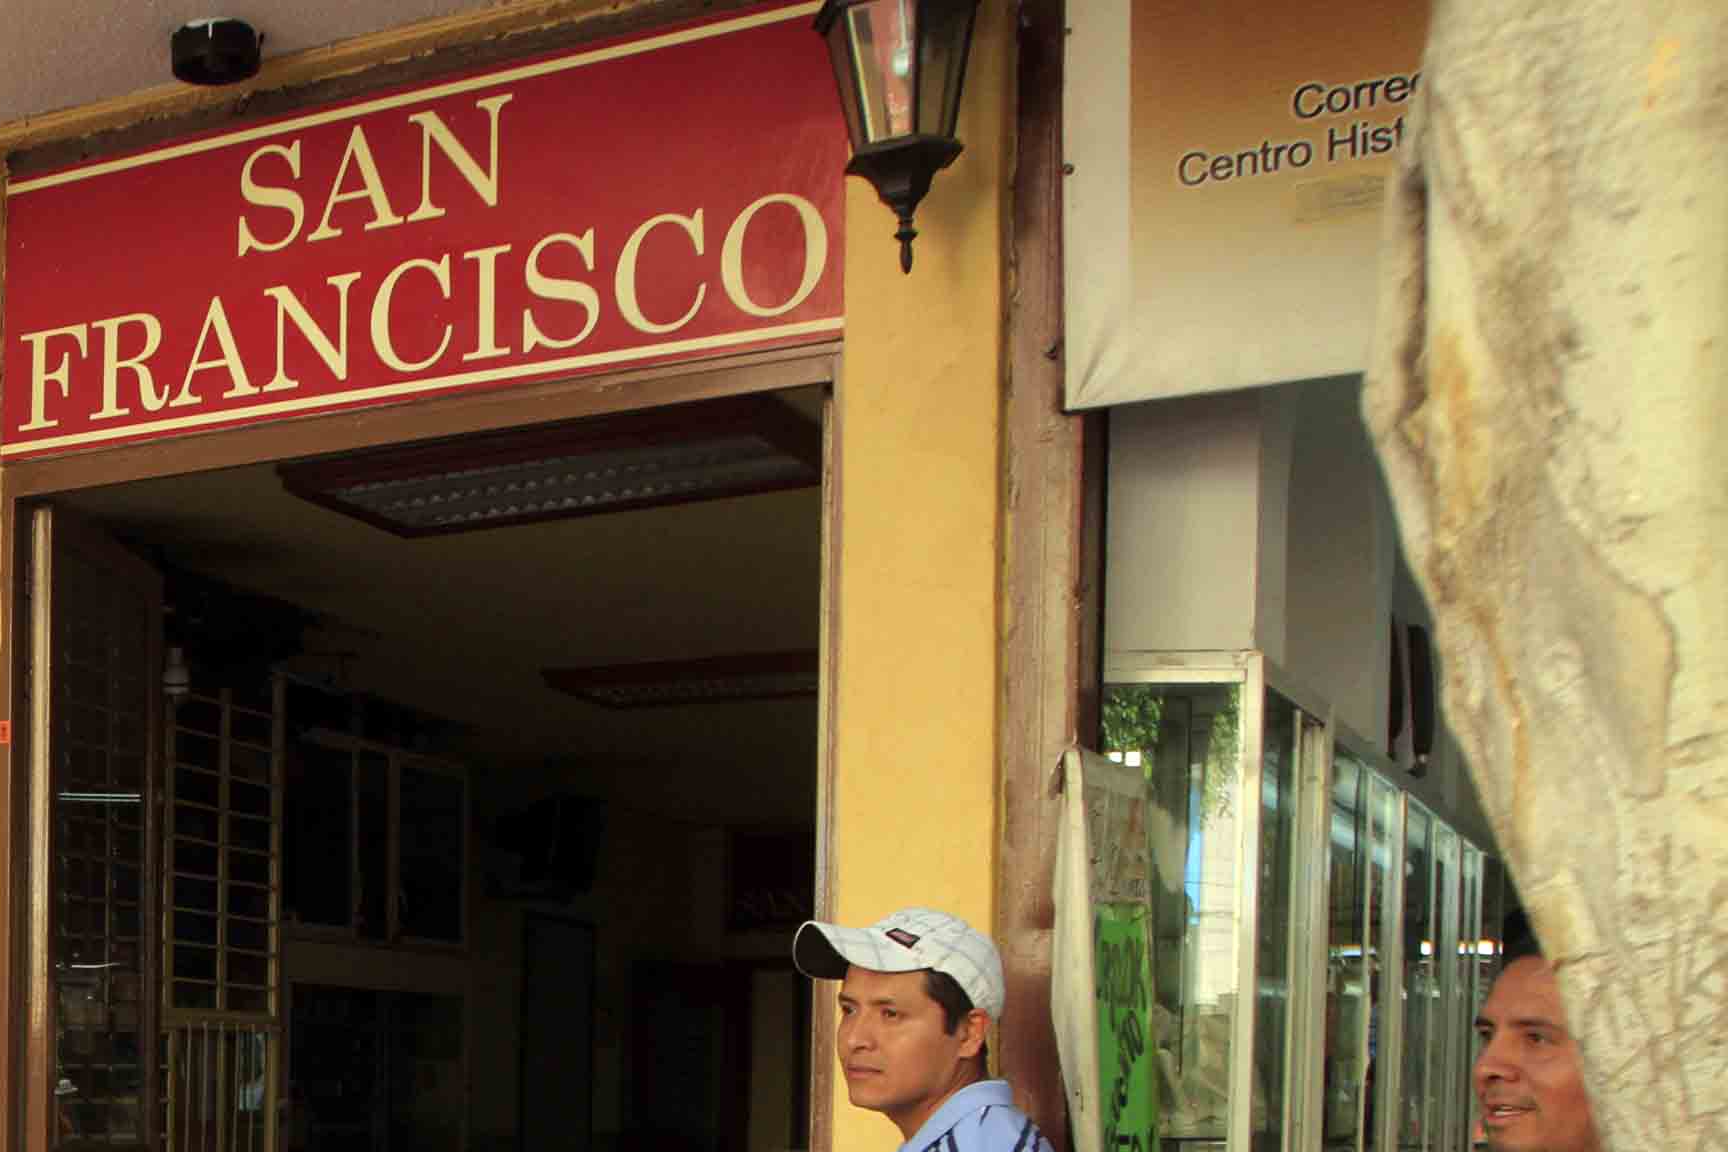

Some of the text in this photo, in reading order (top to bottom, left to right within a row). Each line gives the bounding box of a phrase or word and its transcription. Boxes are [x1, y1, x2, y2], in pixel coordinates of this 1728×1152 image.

[237, 94, 513, 257] SAN
[1178, 141, 1312, 186] Centro
[18, 193, 829, 432] FRANCISCO
